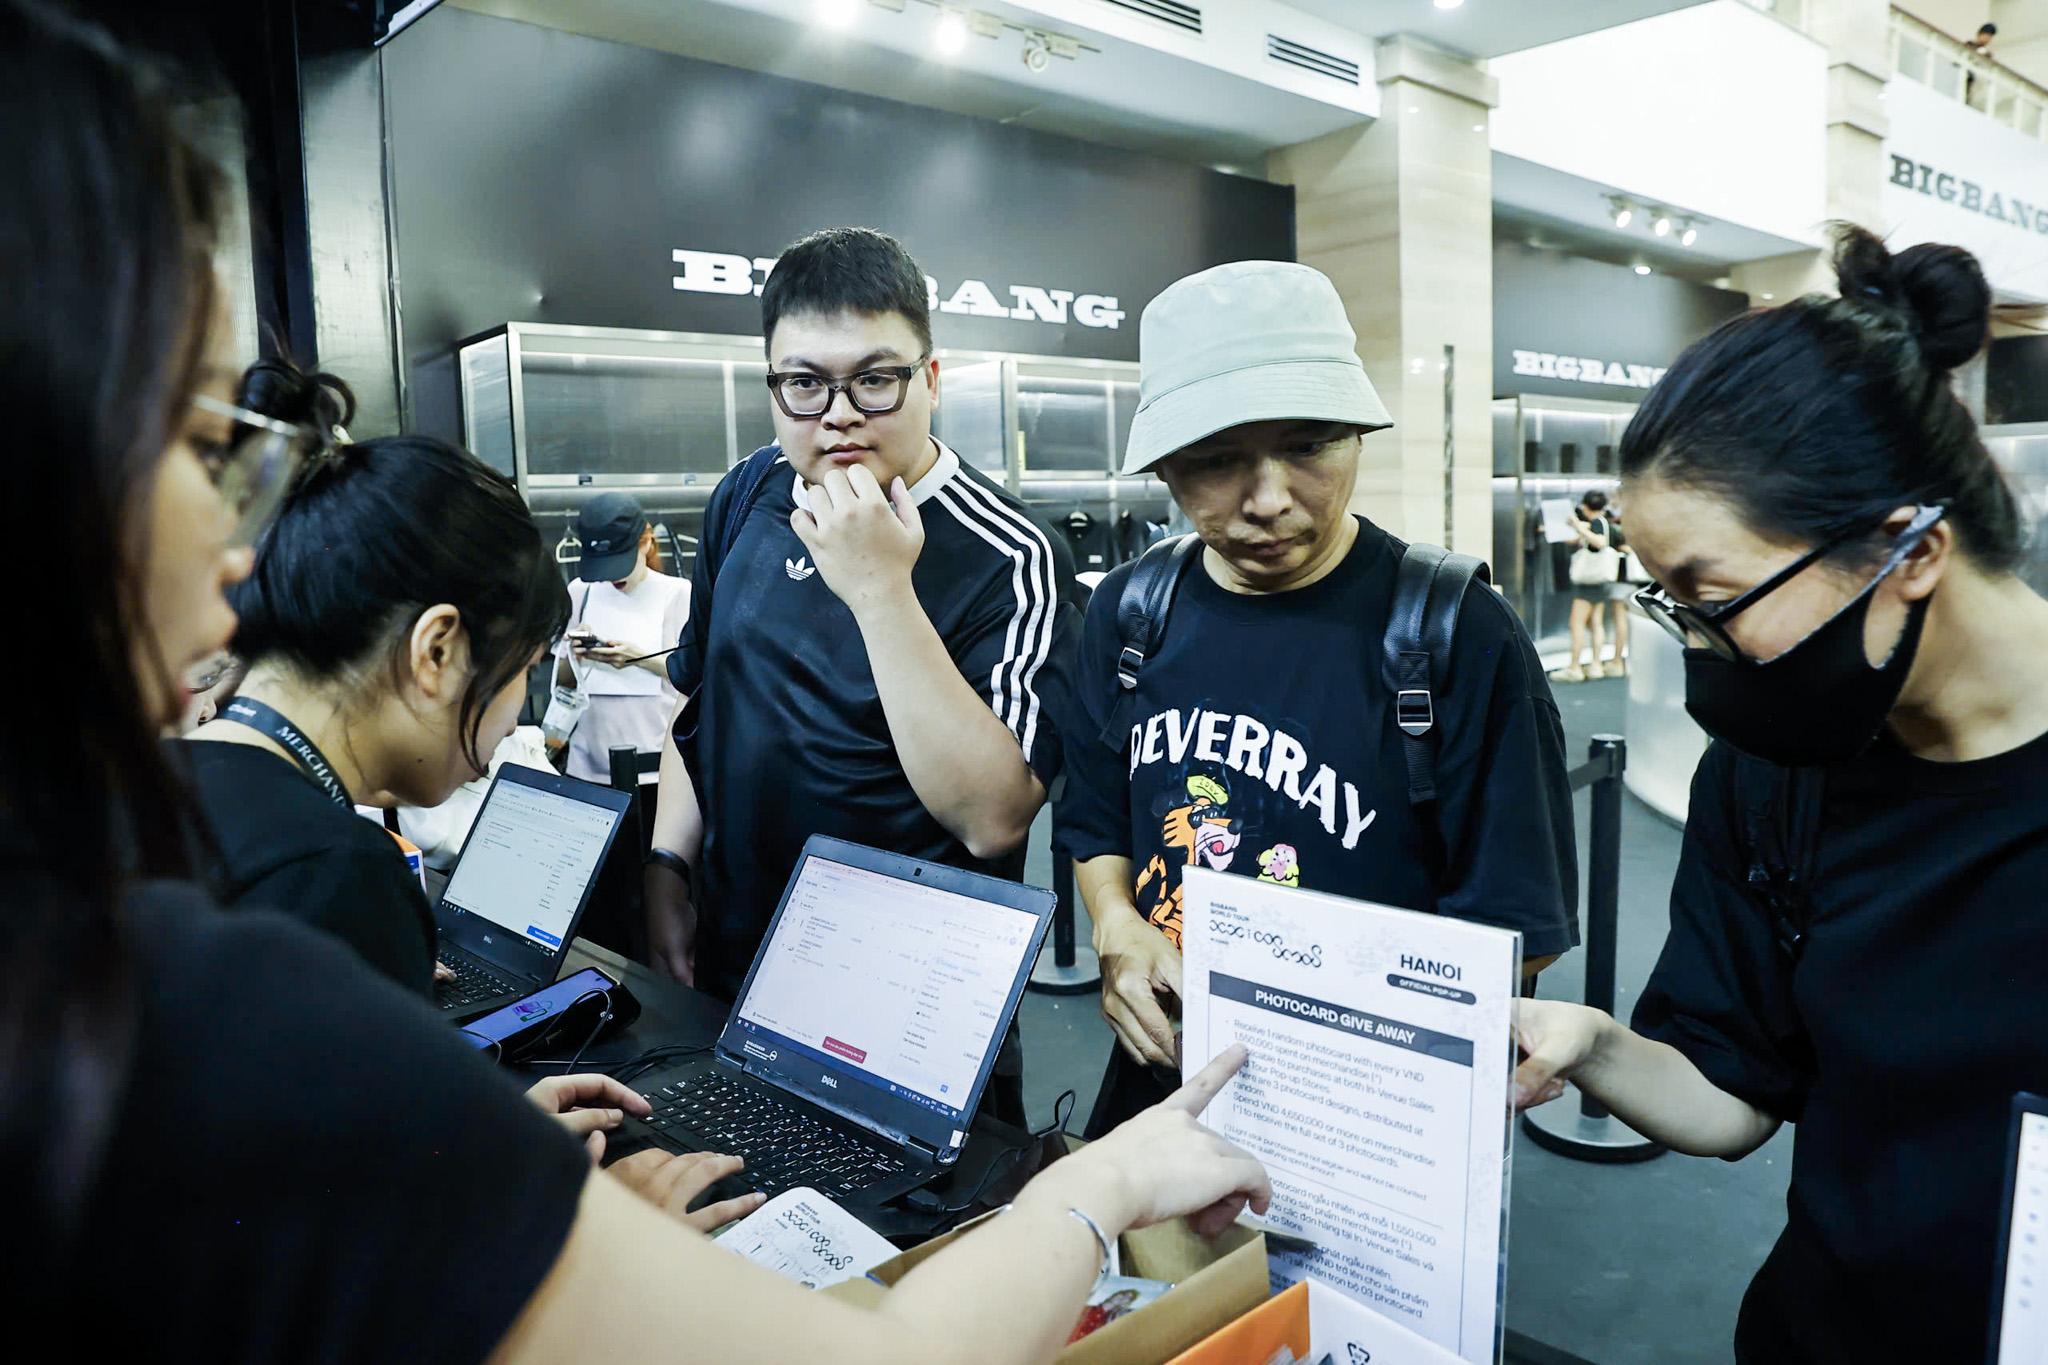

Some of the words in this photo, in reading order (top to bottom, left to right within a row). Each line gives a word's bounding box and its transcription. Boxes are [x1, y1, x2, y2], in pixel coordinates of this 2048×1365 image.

[1890, 154, 2048, 235] BIGBANG
[672, 248, 1126, 330] BANG
[1400, 953, 1460, 981] HANOI
[1255, 988, 1338, 1024] PHOTOCARD
[1339, 1011, 1372, 1033] GIVE
[1375, 1021, 1415, 1045] AWAY
[1272, 1029, 1304, 1047] random
[1305, 1039, 1351, 1063] photocard
[1353, 1053, 1371, 1067] with
[1373, 1059, 1398, 1077] every
[1402, 1067, 1424, 1083] VND
[1312, 1055, 1369, 1080] merchandise
[821, 1075, 838, 1089] DELL
[1344, 1077, 1364, 1091] both
[1238, 1069, 1256, 1082] here
[1280, 1082, 1324, 1107] photocard
[1363, 1109, 1412, 1133] distributed
[1233, 1090, 1259, 1109] Spend
[1260, 1100, 1278, 1114] VND
[1336, 1127, 1359, 1141] more
[1374, 1138, 1436, 1167] merchandise
[1284, 1120, 1297, 1133] the
[1341, 1215, 1399, 1245] merchandise
[1360, 1284, 1373, 1298] 03
[1374, 1290, 1422, 1320] photocard
